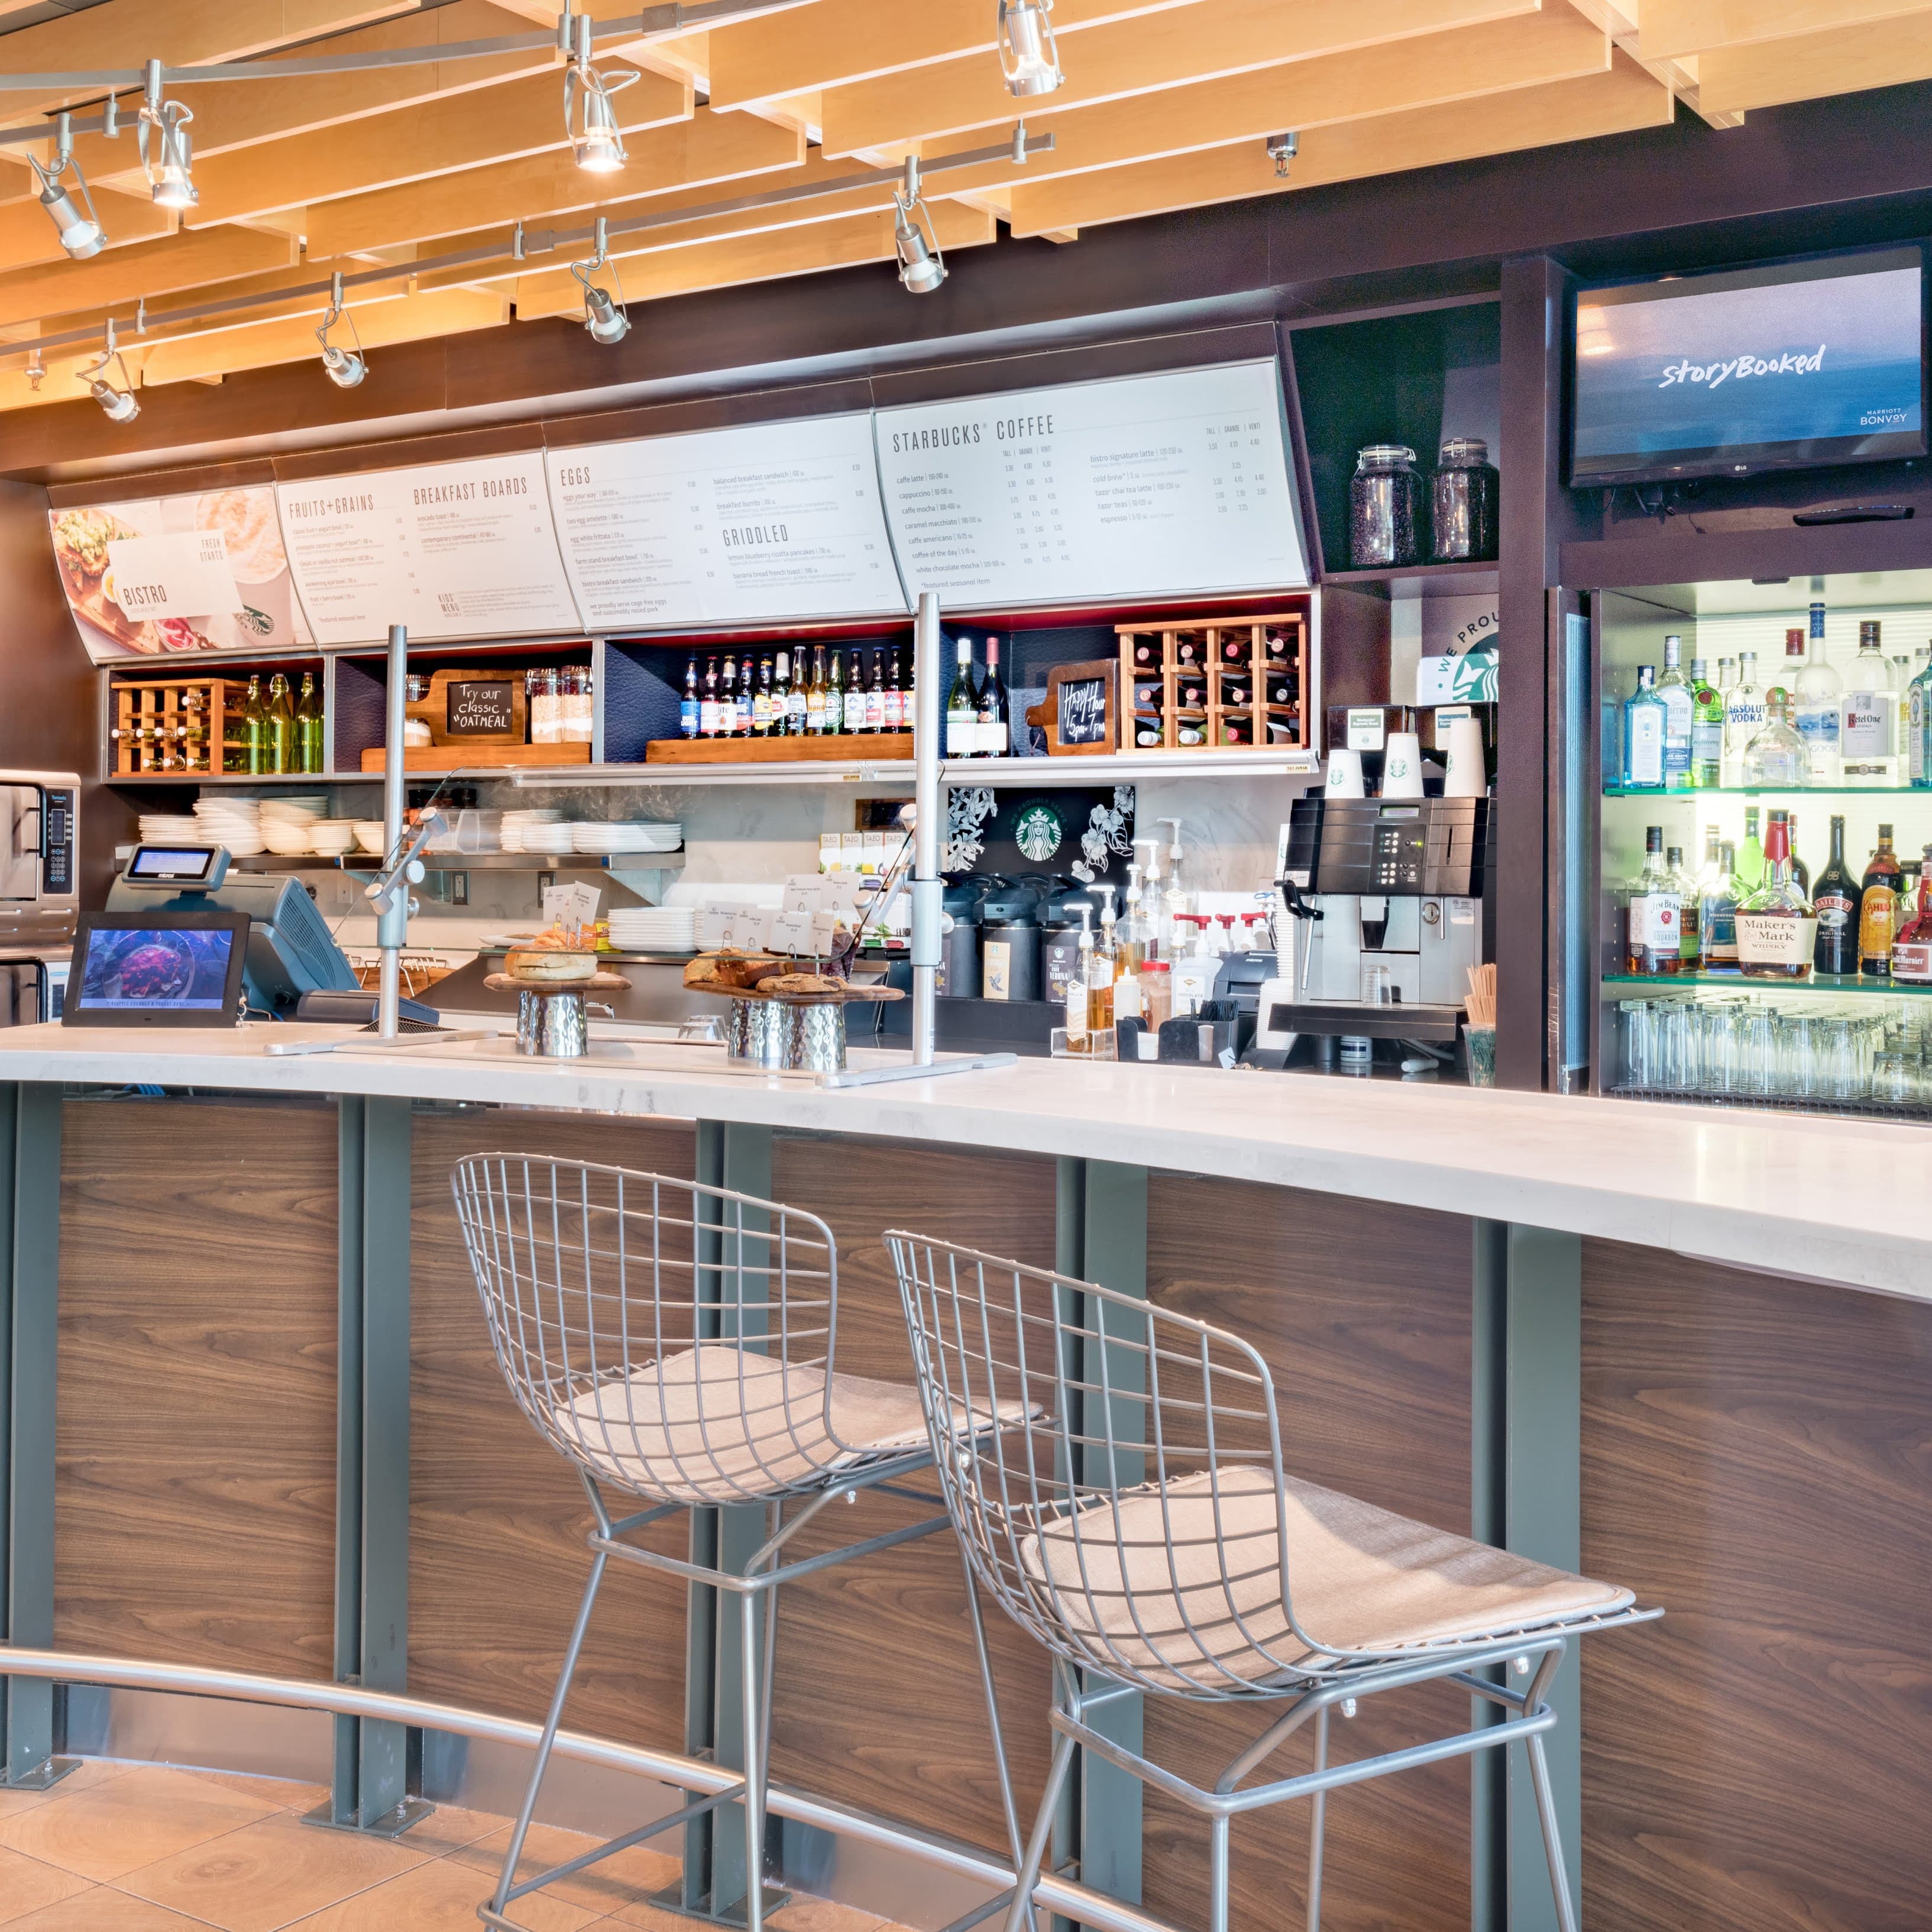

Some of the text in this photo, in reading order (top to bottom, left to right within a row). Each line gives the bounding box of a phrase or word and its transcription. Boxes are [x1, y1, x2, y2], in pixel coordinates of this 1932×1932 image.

[1658, 344, 1826, 389] storyBooked
[1860, 413, 1907, 426] BONVOY
[996, 415, 1054, 440] COFFEE
[1225, 425, 1240, 433] GRANDE
[1248, 422, 1261, 431] VENTI
[1090, 454, 1108, 463] bistro
[1109, 451, 1139, 462] signature
[1140, 449, 1155, 458] latte
[561, 467, 590, 486] EGGS
[713, 471, 789, 485] balanced breakfast sandwich
[911, 474, 924, 483] latte
[1093, 474, 1106, 483] cold
[414, 477, 528, 504] BREAKFAST BOARDS
[1112, 486, 1126, 495] chai
[1137, 483, 1153, 493] latte
[899, 490, 931, 500] cappuccino
[717, 501, 742, 510] breakfast
[917, 504, 936, 513] mocha
[1114, 500, 1128, 508] teas
[905, 519, 957, 530] caramel macchiato
[1100, 514, 1128, 525] espresso
[421, 532, 476, 544] contemporary continental
[723, 525, 788, 546] GRIDDLED
[202, 539, 220, 549] FRESH
[200, 550, 223, 562] STARTS
[601, 555, 625, 563] breakfast
[745, 551, 771, 561] blueberry
[771, 550, 789, 558] ricotta
[789, 548, 815, 558] pancakes
[912, 551, 929, 559] coffee
[947, 549, 957, 558] day
[769, 569, 787, 577] french
[933, 564, 960, 572] chocolate
[597, 578, 620, 587] breakfast
[620, 576, 643, 585] sandwich
[949, 579, 976, 587] seasonal
[124, 585, 167, 606] BISTRO
[441, 603, 459, 613] MENU
[598, 601, 616, 610] proudly
[603, 607, 630, 616] sustainably
[647, 606, 658, 614] pork
[1438, 647, 1457, 672] WE
[459, 683, 501, 706] Try our
[458, 701, 500, 714] classic
[1729, 704, 1765, 714] ABSOLUT
[1732, 714, 1763, 723] VODKA
[1849, 714, 1881, 726] Ketel One
[1651, 902, 1663, 914] JIM
[1816, 898, 1850, 908] BAILEYS
[1745, 920, 1796, 930] Maker's
[1653, 933, 1678, 941] BOURBON
[1759, 931, 1795, 941] Mark
[1049, 972, 1068, 980] VERONA
